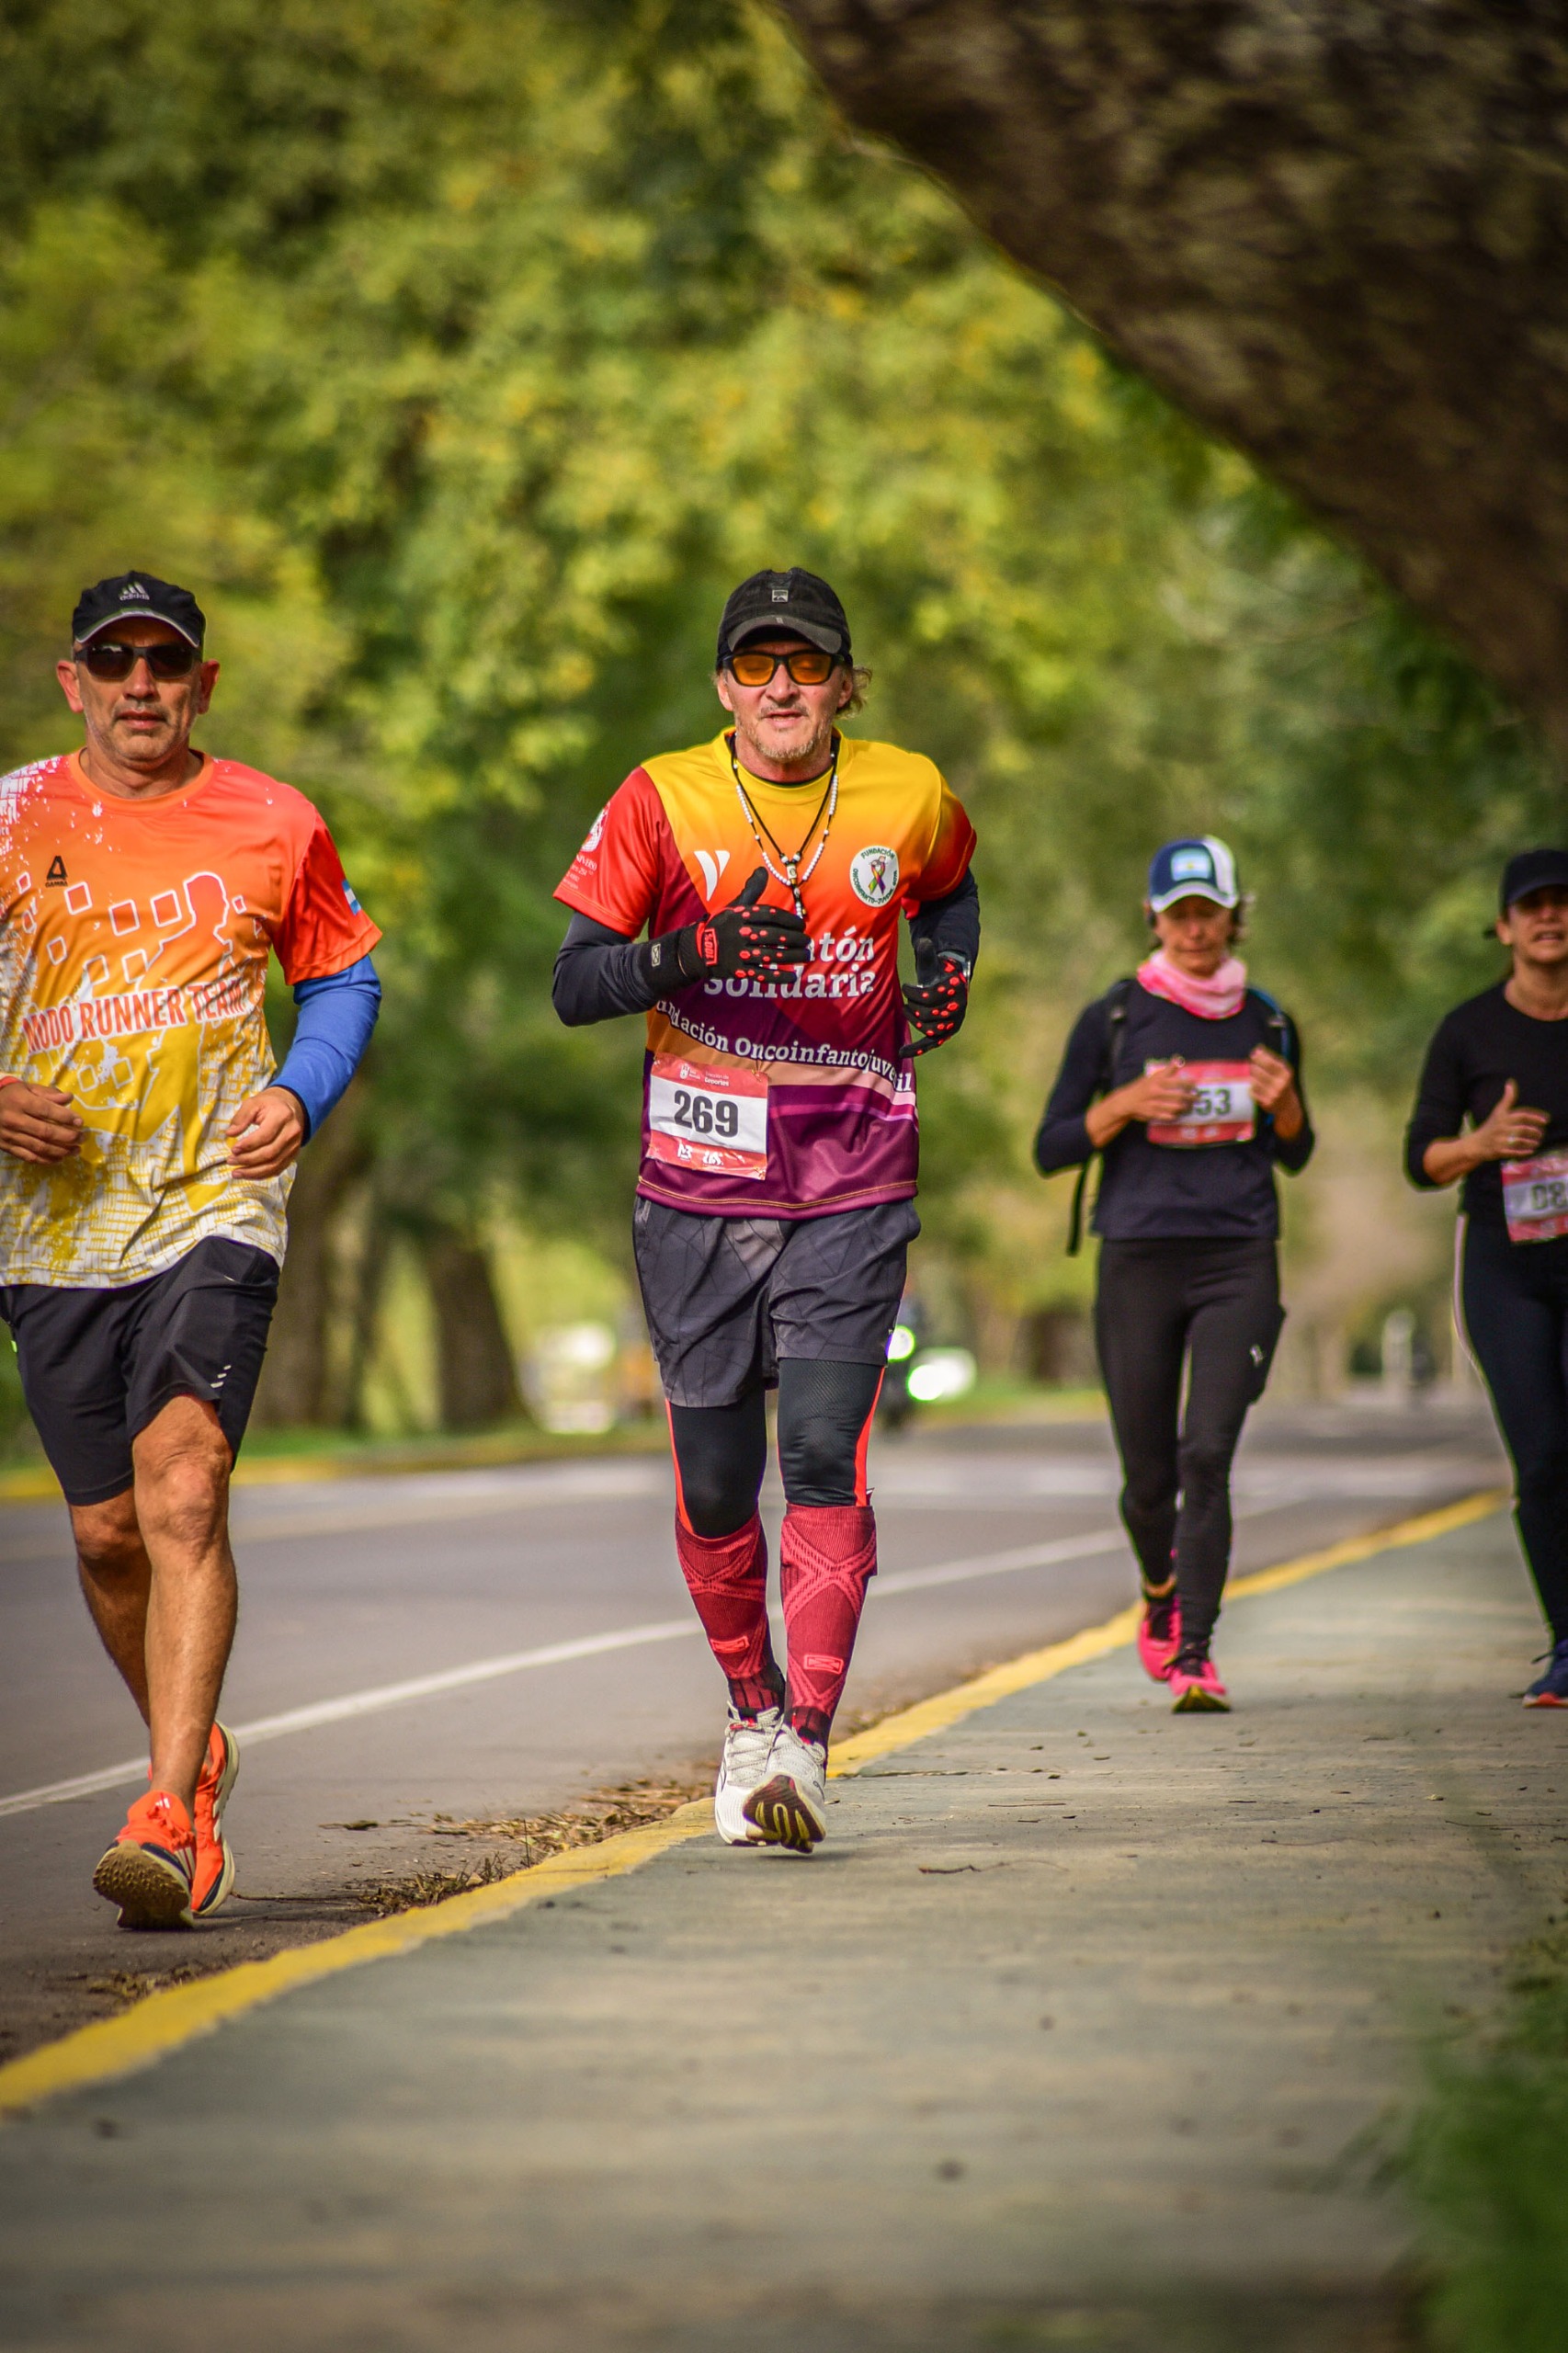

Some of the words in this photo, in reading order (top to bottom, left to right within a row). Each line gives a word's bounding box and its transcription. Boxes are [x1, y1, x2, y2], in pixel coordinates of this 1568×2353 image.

[809, 926, 874, 962] tón
[22, 1005, 74, 1054] MODO
[79, 985, 186, 1039] RUNNER
[187, 978, 244, 1021] TEAM
[656, 1000, 729, 1051] undación
[674, 1089, 739, 1138] 269
[1194, 1088, 1231, 1115] 53
[1531, 1181, 1568, 1210] 08
